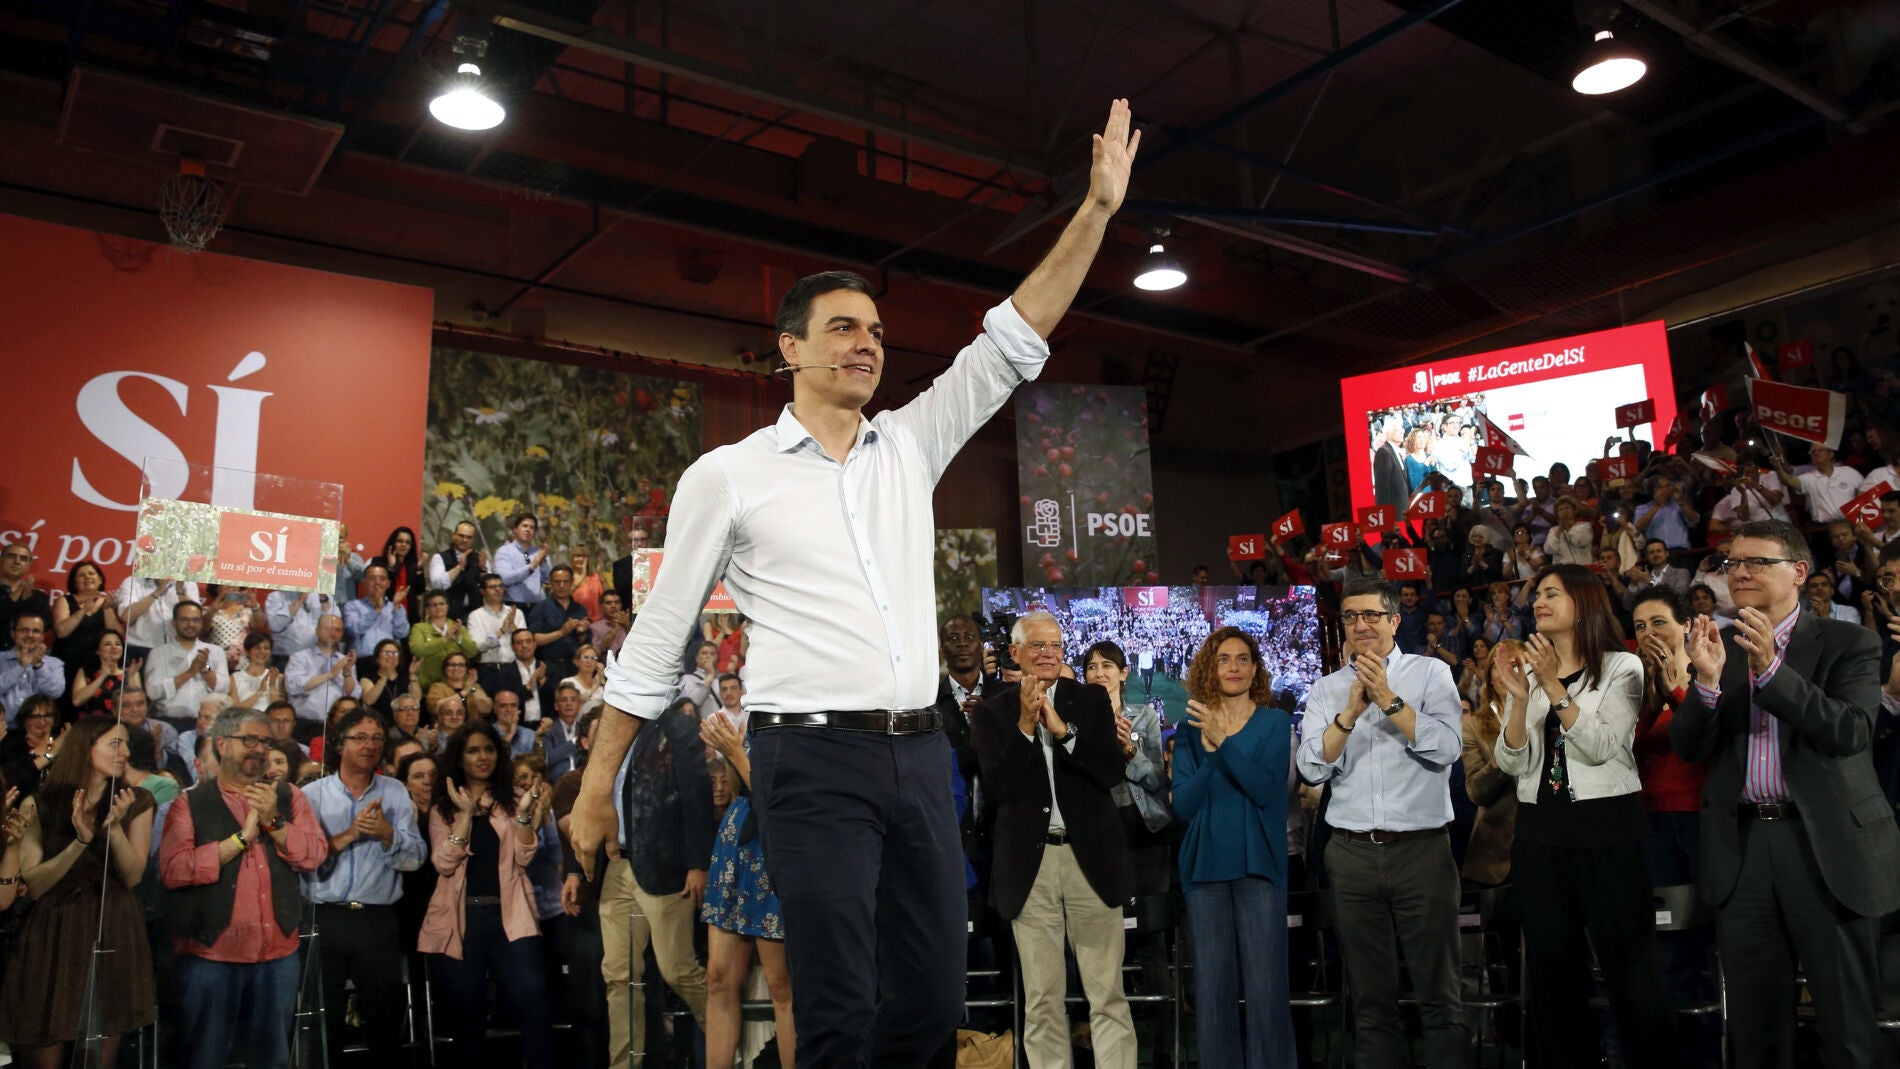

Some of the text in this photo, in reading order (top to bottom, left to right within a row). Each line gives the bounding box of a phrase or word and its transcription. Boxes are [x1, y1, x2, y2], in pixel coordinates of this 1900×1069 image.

[1433, 346, 1585, 387] PSOE #LaGenteDelSí
[1625, 404, 1643, 422] SÍ
[1757, 406, 1823, 433] PSOE
[71, 351, 274, 512] SÍ
[1608, 460, 1627, 479] SÍ
[1418, 496, 1435, 514] SÍ
[1087, 513, 1151, 537] PSOE
[1279, 516, 1294, 536] SÍ
[1367, 509, 1385, 527] SÍ
[1332, 526, 1349, 543] SÍ
[250, 526, 289, 564] SÍ
[1239, 538, 1255, 555] SÍ
[220, 562, 234, 571] un
[246, 565, 265, 575] por
[266, 565, 276, 575] el
[277, 567, 313, 578] cambio
[1395, 552, 1414, 573] SÍ
